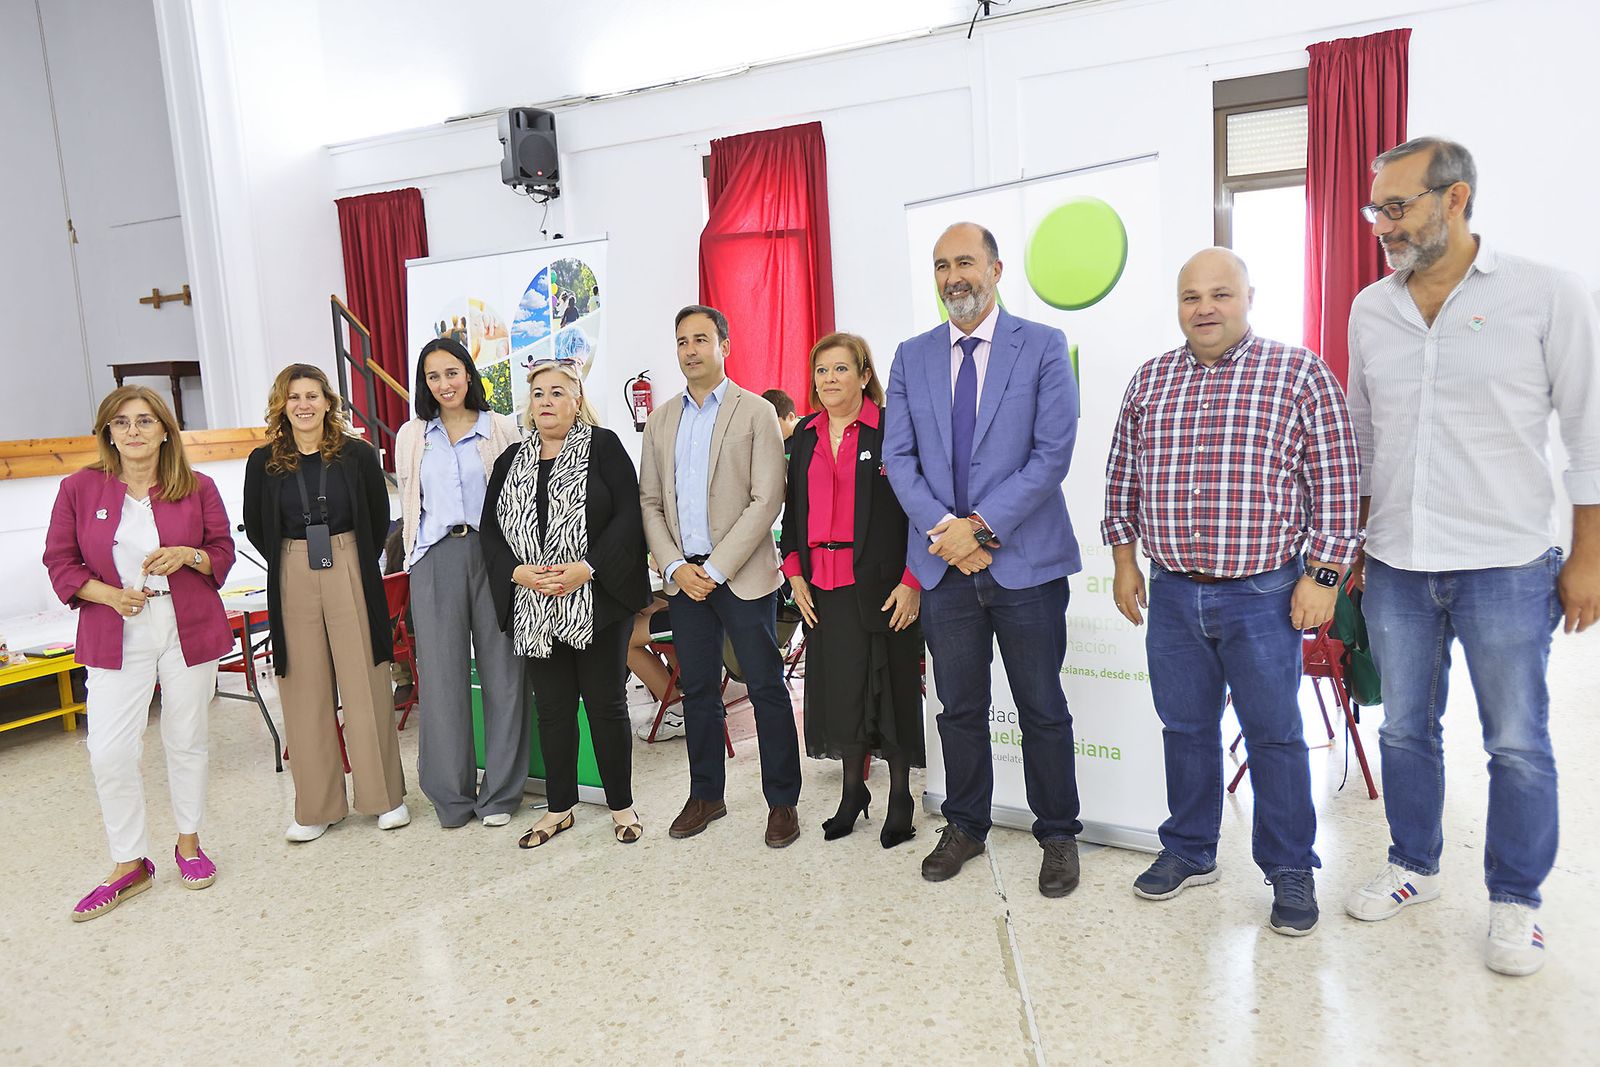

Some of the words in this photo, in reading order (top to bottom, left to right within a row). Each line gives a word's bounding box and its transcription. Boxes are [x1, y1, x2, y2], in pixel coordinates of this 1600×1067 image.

[1060, 664, 1098, 679] esianas,
[1100, 667, 1130, 680] desde
[1133, 671, 1150, 684] 187
[988, 705, 1016, 724] dac
[990, 725, 1023, 746] uela
[1074, 738, 1121, 761] siana
[992, 753, 1023, 765] cuelate
